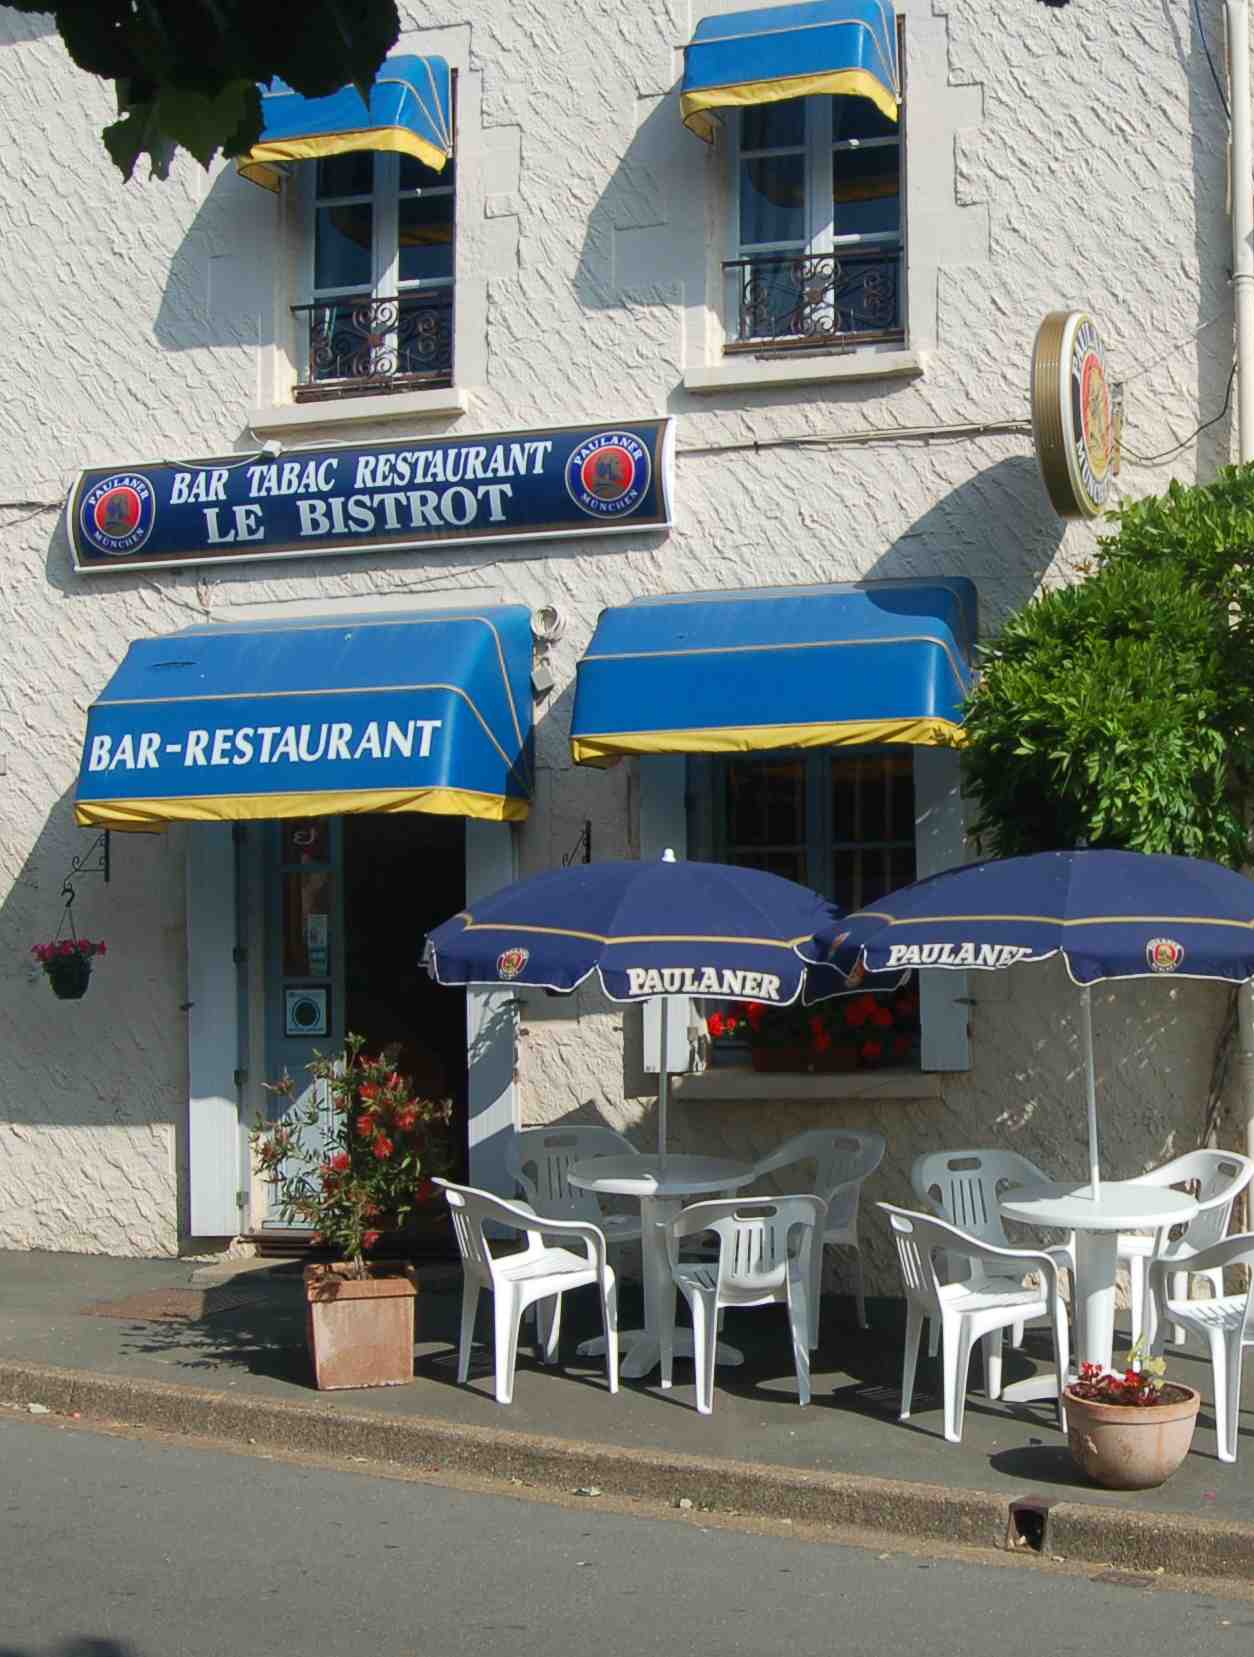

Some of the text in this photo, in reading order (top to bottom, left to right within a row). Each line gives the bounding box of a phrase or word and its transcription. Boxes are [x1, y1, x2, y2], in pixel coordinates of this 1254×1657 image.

[169, 441, 552, 505] BAR TABAC RESTAURANT
[574, 435, 643, 465] PAULANER
[203, 483, 513, 544] LE BISTROT
[88, 719, 442, 772] BAR-RESTAURANT
[626, 967, 781, 1000] PAULANER
